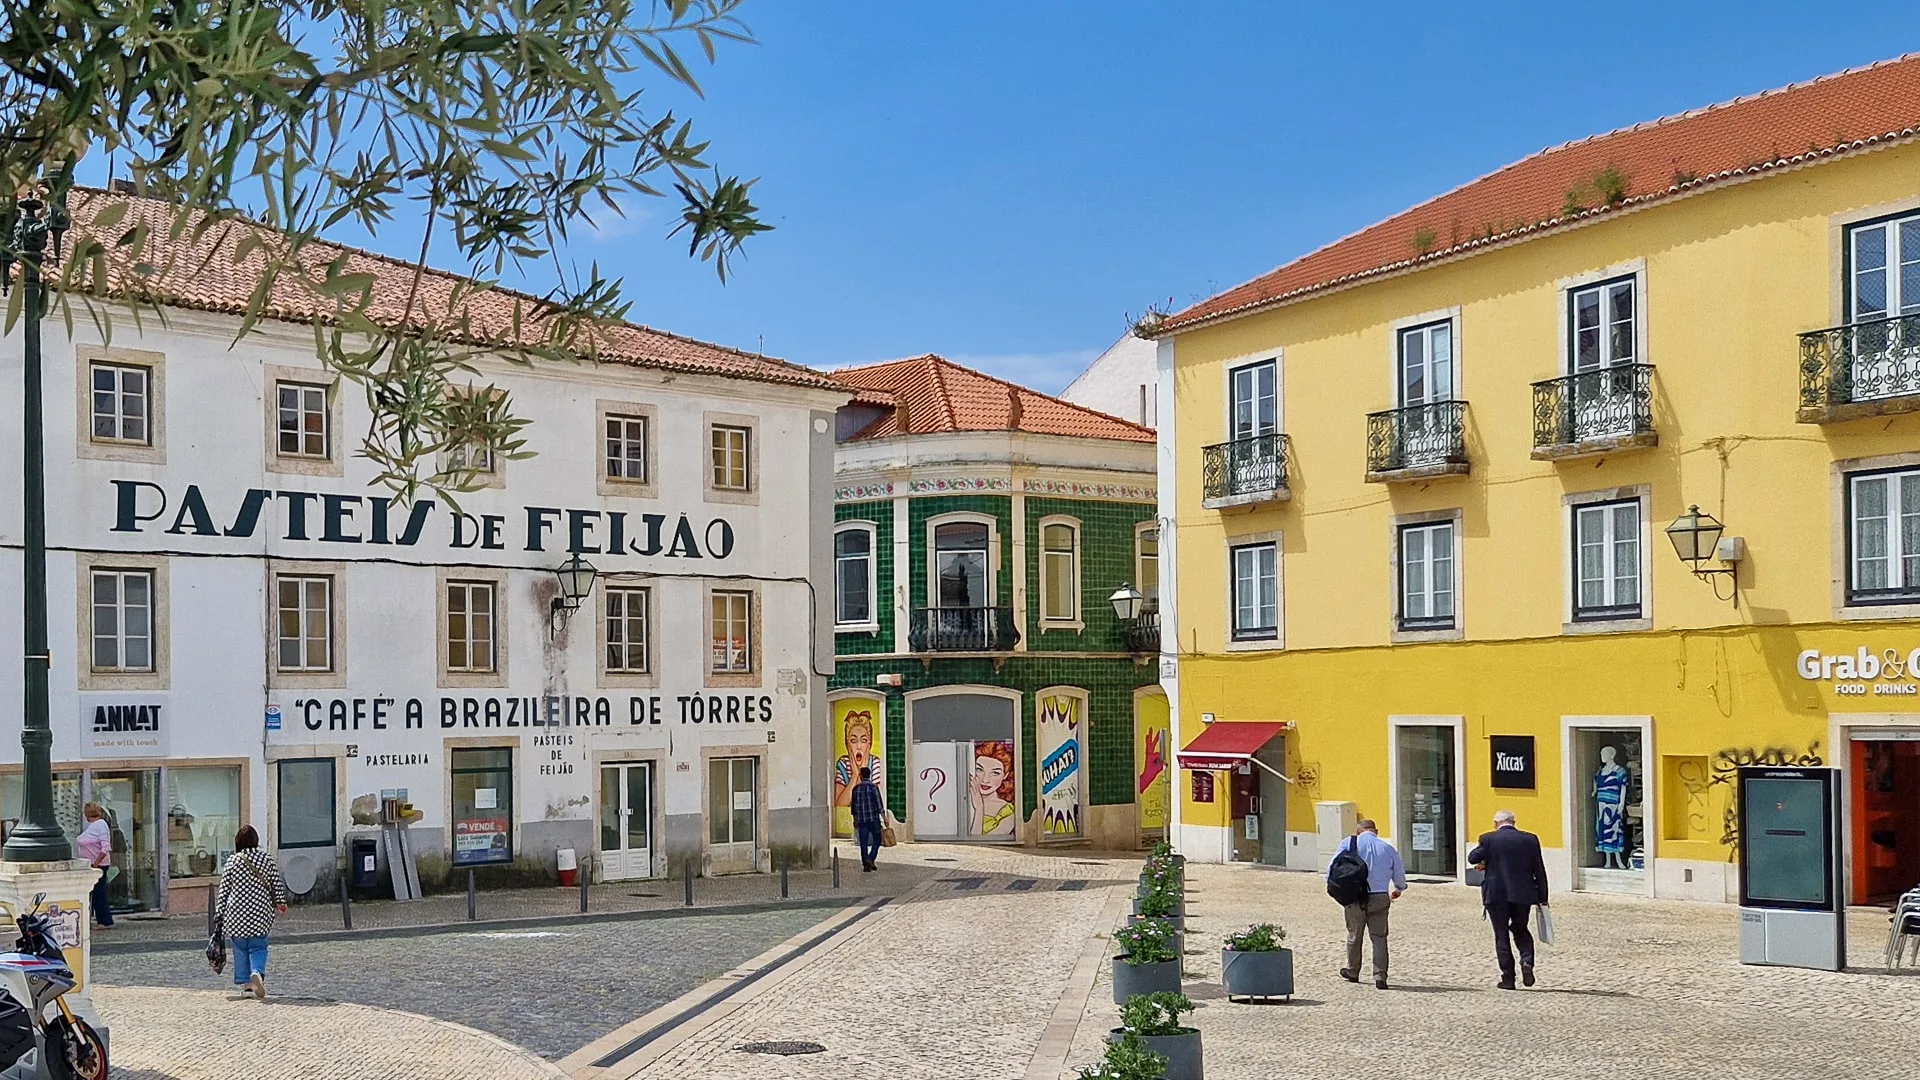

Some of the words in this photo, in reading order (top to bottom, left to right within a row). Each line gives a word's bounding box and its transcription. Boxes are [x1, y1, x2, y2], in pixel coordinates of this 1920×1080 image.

[109, 479, 436, 546] PASTEIS
[449, 511, 505, 550] DE
[523, 505, 735, 560] FEIJÃO
[1835, 683, 1866, 695] FOOD
[1874, 683, 1918, 695] DRINKS
[405, 698, 423, 729] A
[440, 696, 611, 729] BRAZILEIRA
[630, 696, 661, 725] DE
[677, 690, 772, 725] TÔRRES
[93, 705, 162, 732] ANNAT
[94, 739, 115, 748] made
[117, 738, 134, 747] with
[136, 738, 158, 747] touch
[533, 735, 574, 747] PASTEIS
[366, 753, 429, 767] PASTELARIA
[551, 749, 562, 761] DE
[1496, 751, 1524, 772] Xiccas
[469, 822, 495, 832] VENDE
